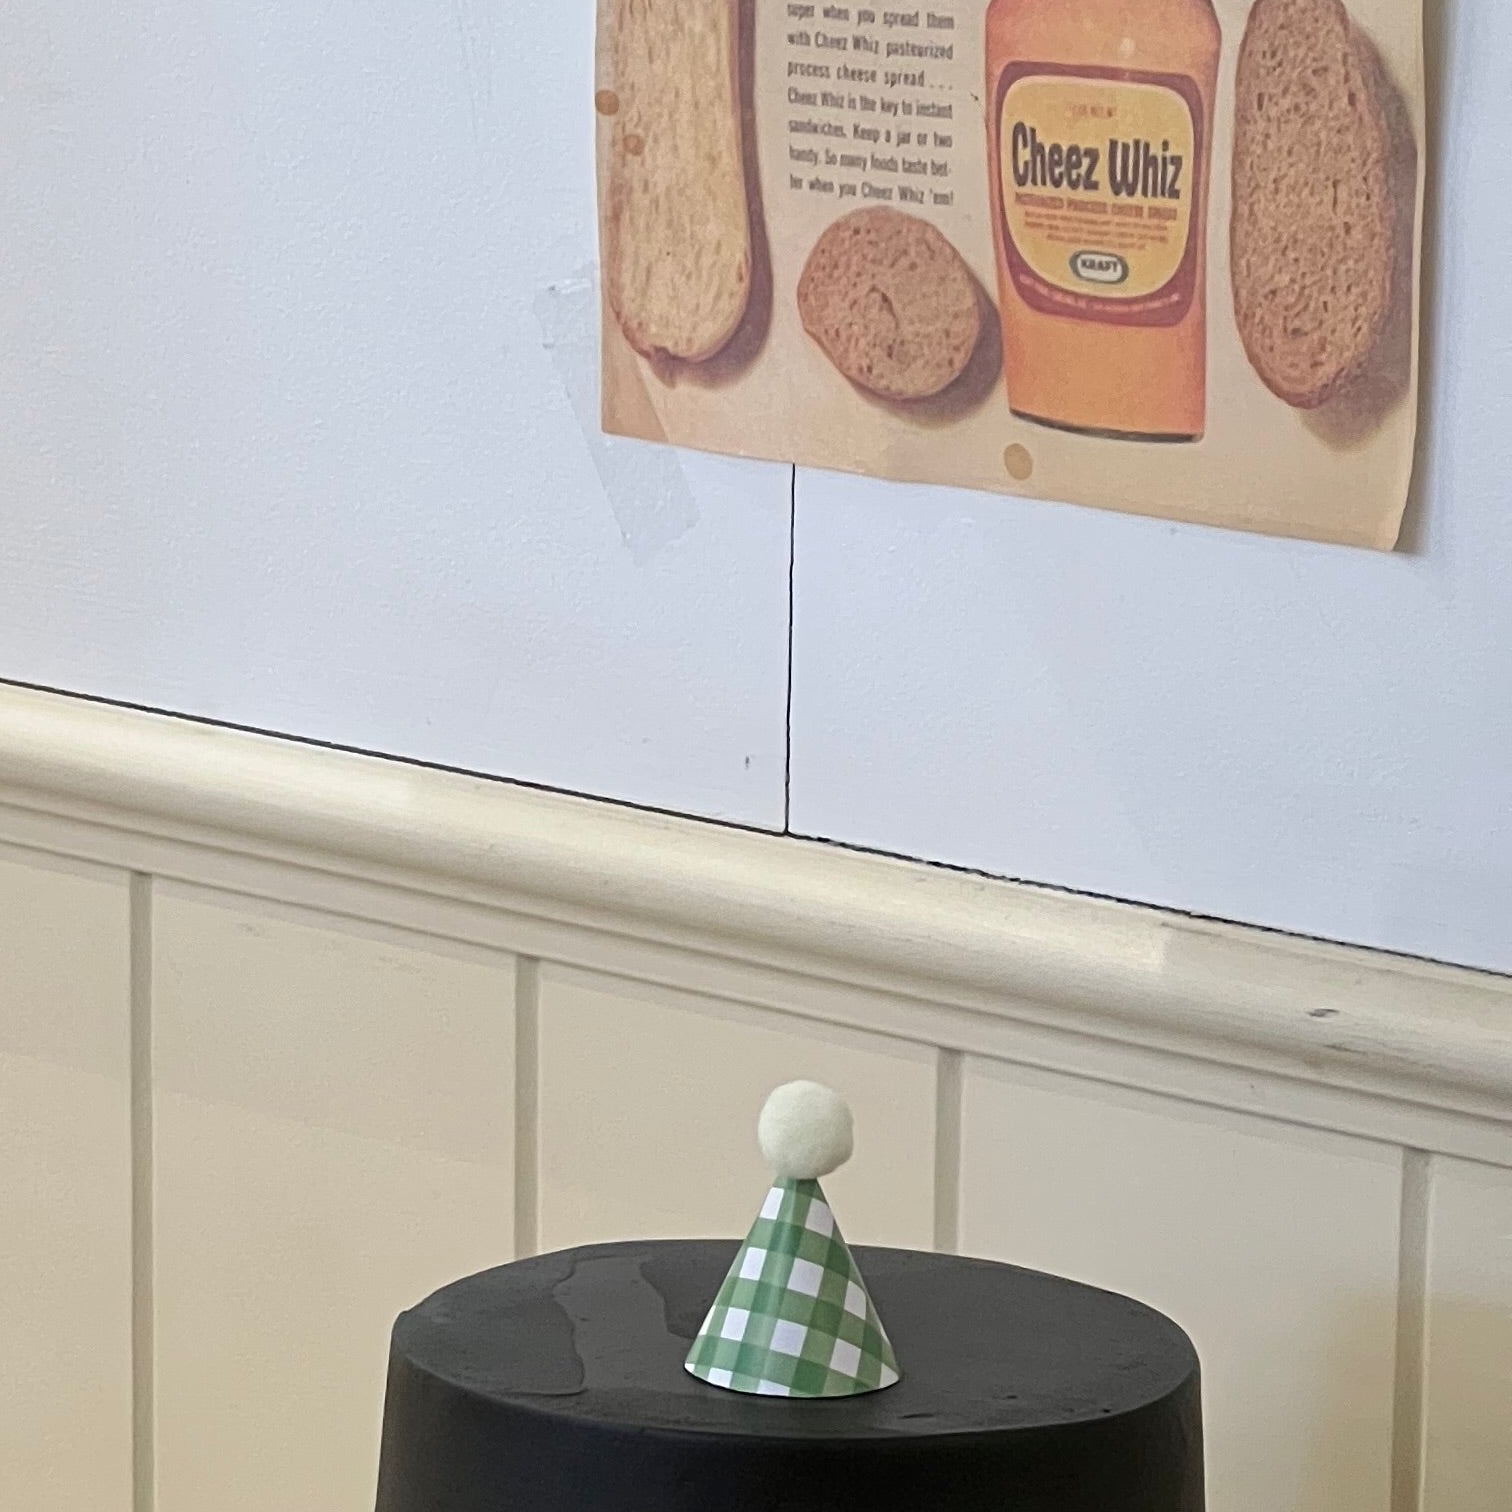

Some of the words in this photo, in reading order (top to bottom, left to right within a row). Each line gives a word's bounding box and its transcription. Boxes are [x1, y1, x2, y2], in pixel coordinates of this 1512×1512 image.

[823, 6, 850, 21] when
[857, 9, 876, 26] you
[883, 10, 920, 28] spread
[927, 12, 955, 29] them
[787, 32, 811, 47] with
[815, 31, 848, 51] Cheez
[852, 35, 880, 55] Whiz
[886, 40, 954, 61] pasteurized
[787, 61, 831, 79] process
[836, 64, 877, 83] cheese
[884, 70, 925, 88] spread
[787, 87, 818, 106] Cheez
[821, 92, 845, 110] Whiz
[848, 93, 857, 110] is
[860, 95, 876, 111] the
[880, 97, 898, 117] key
[902, 99, 913, 115] to
[916, 101, 953, 120] instant
[788, 119, 847, 138] sandwiches.
[853, 123, 880, 143] Keep
[884, 130, 892, 143] a
[896, 131, 911, 147] jar
[917, 133, 928, 146] or
[934, 131, 953, 148] two
[824, 148, 838, 165] So
[840, 153, 868, 172] many
[870, 154, 899, 173] foods
[902, 157, 928, 175] taste
[1011, 121, 1100, 192] Cheez
[1107, 138, 1184, 200] Whiz
[809, 177, 834, 193] when
[839, 182, 857, 198] you
[861, 181, 893, 201] Cheez
[898, 185, 925, 205] Whiz
[1080, 259, 1120, 272] KRAFT
